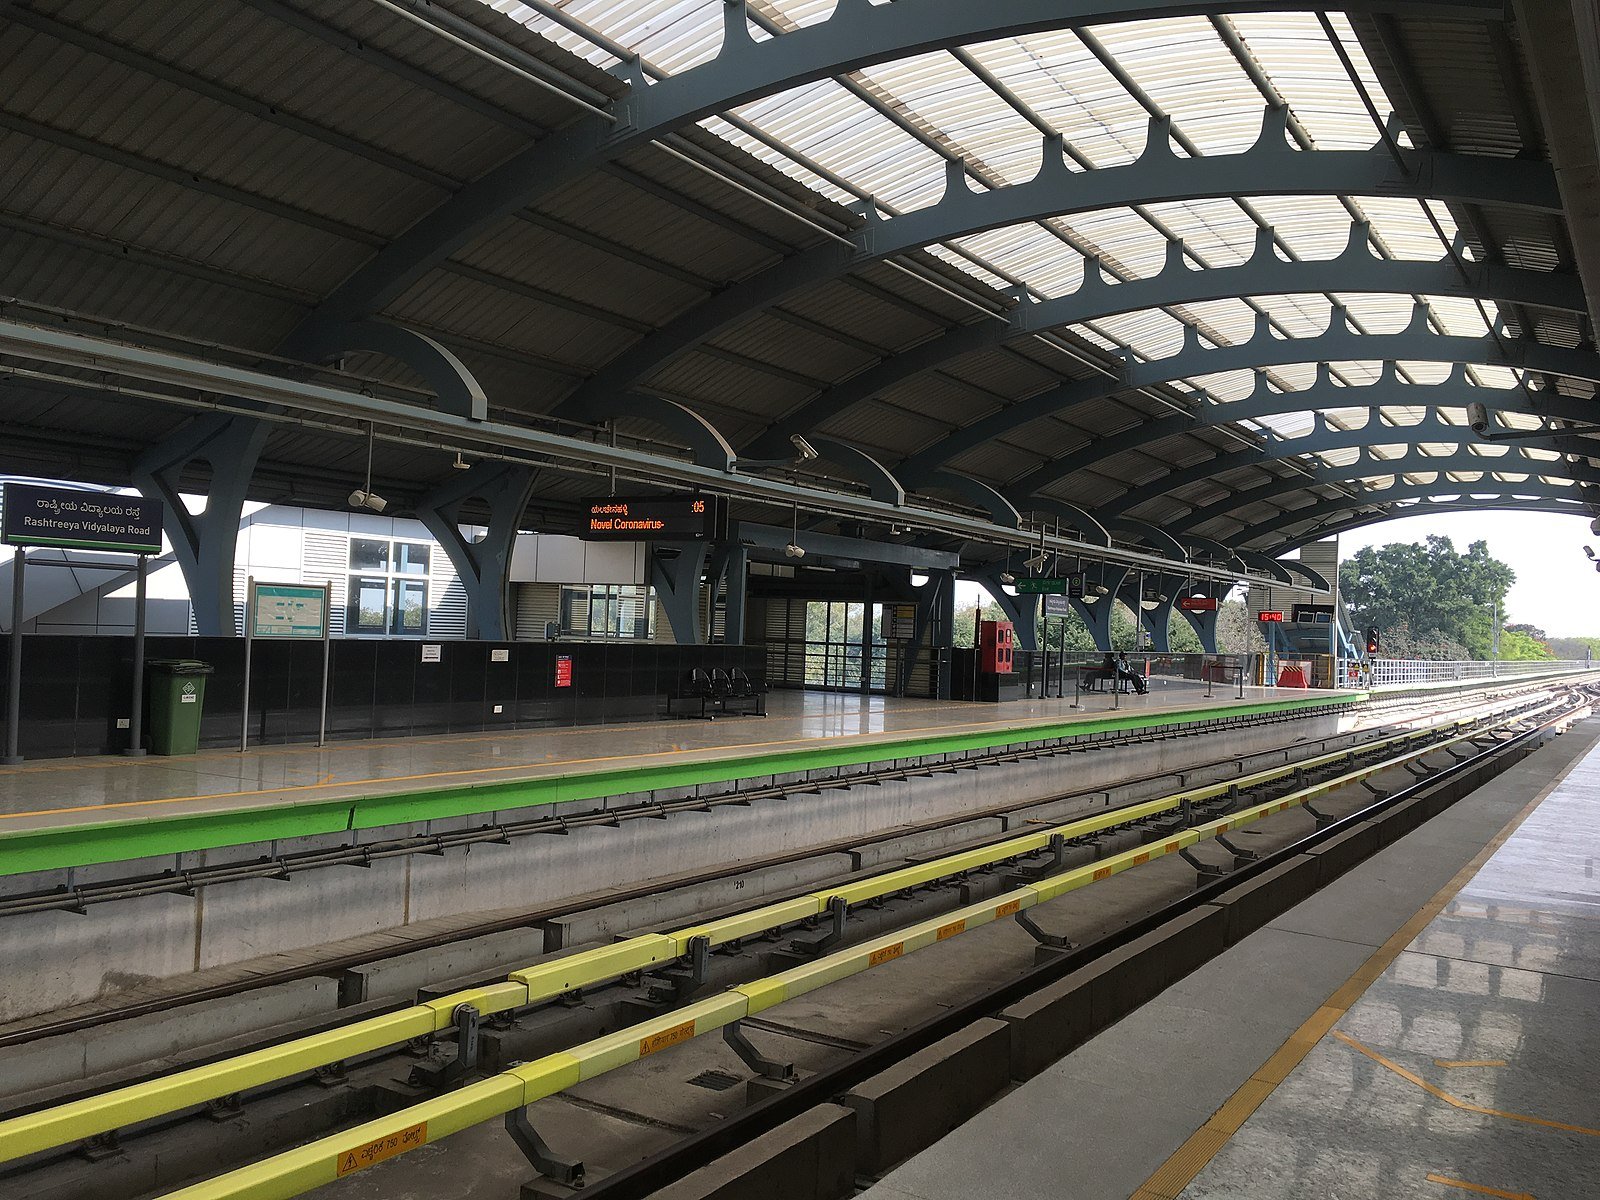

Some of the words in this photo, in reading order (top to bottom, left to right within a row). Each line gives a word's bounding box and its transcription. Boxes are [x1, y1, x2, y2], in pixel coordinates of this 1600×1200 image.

[37, 499, 78, 515] ರಾಷ್ಟ್ರೀಯ
[80, 502, 123, 518] ವಿದ್ಯಾಲಯ
[125, 507, 141, 520] ರಸ್ತೆ
[24, 516, 80, 531] Rashtreeya
[82, 520, 126, 535] Vidyalaya
[127, 525, 151, 536] Road
[590, 518, 613, 530] Novel
[614, 518, 665, 530] Coronavirus-
[1260, 613, 1282, 621] 15:40
[386, 1137, 398, 1149] 750
